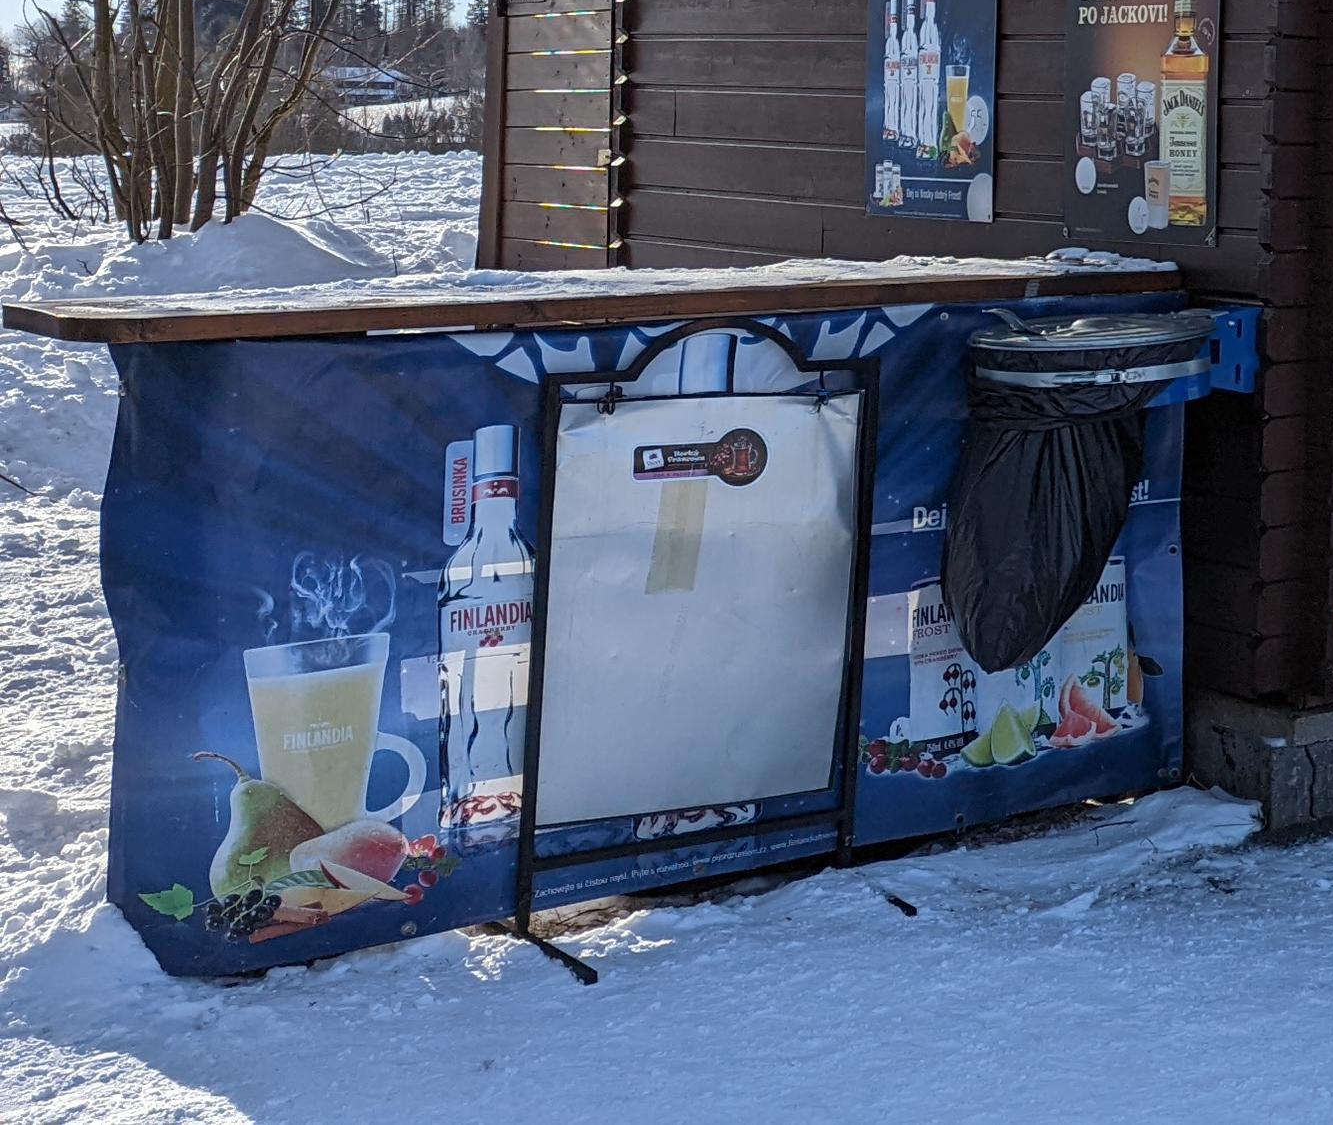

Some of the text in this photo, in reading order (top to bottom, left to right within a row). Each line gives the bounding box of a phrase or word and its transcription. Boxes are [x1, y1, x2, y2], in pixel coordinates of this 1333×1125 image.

[1078, 4, 1168, 25] PO JACKOVI!
[1163, 94, 1180, 116] JACK
[1168, 149, 1198, 158] HONEY
[450, 457, 468, 525] BRUSINKA
[1130, 479, 1150, 502] st!
[450, 601, 533, 633] FINLANDIA
[912, 624, 951, 642] FROST
[283, 725, 354, 750] FINLANDIA
[584, 877, 608, 888] čistou
